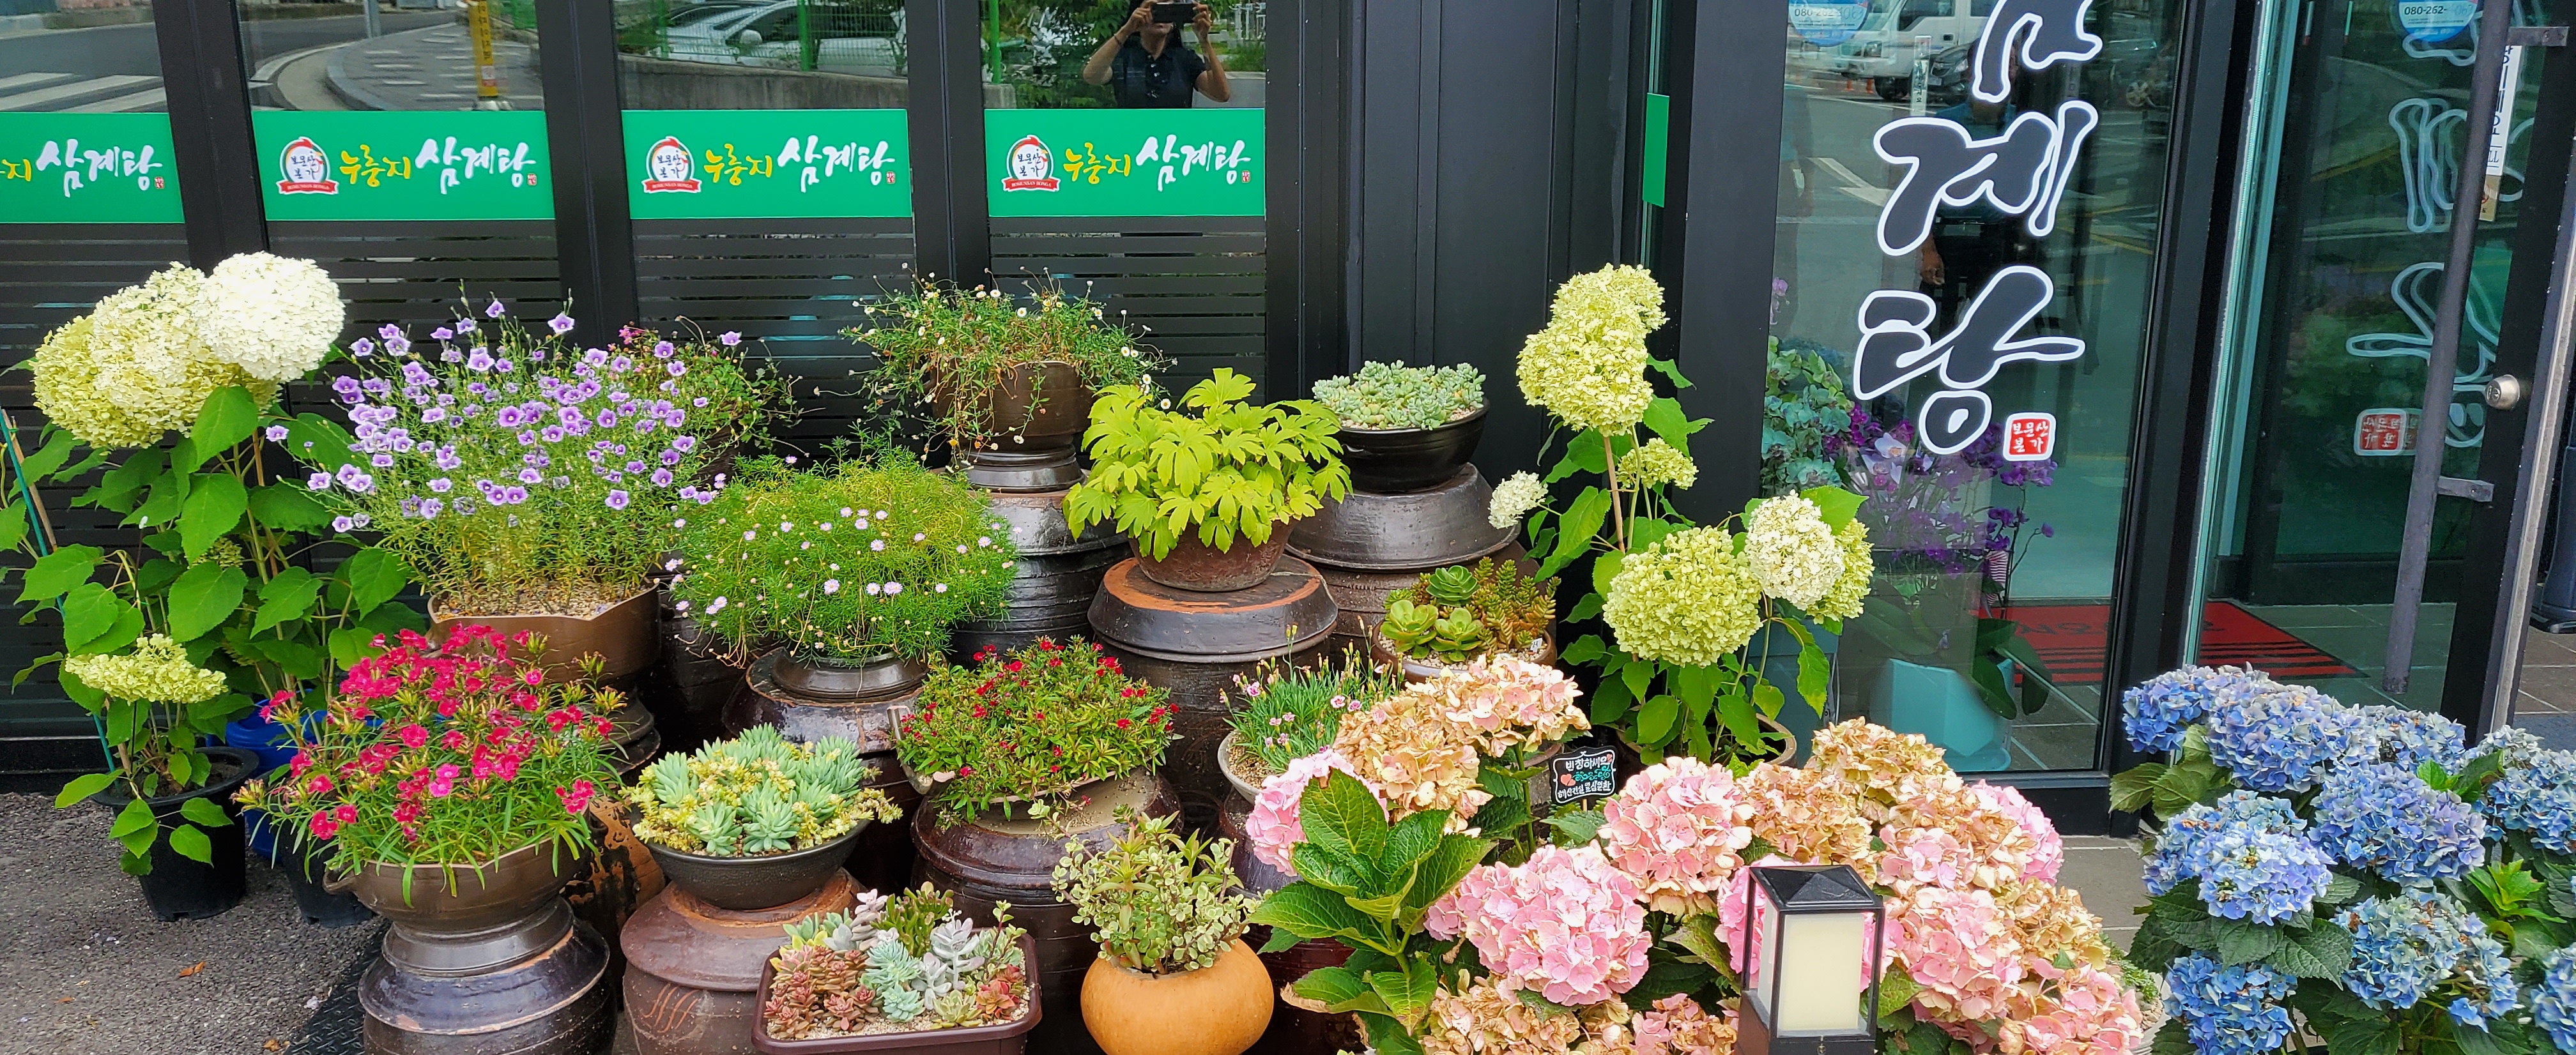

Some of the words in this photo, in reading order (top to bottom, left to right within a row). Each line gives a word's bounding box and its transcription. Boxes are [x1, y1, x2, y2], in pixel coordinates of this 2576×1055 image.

[36, 139, 162, 197] 삼계탕
[339, 144, 411, 187] 누룽지
[415, 136, 537, 195] 삼계탕
[657, 154, 682, 165] 보문산
[703, 143, 772, 186] 누룽지
[777, 135, 895, 193] 삼계탕
[1017, 153, 1041, 164] 보문산
[1063, 142, 1131, 185] 누룽지
[1135, 134, 1252, 192] 삼계탕
[2012, 421, 2049, 437] 보문산
[2013, 437, 2044, 453] 본가
